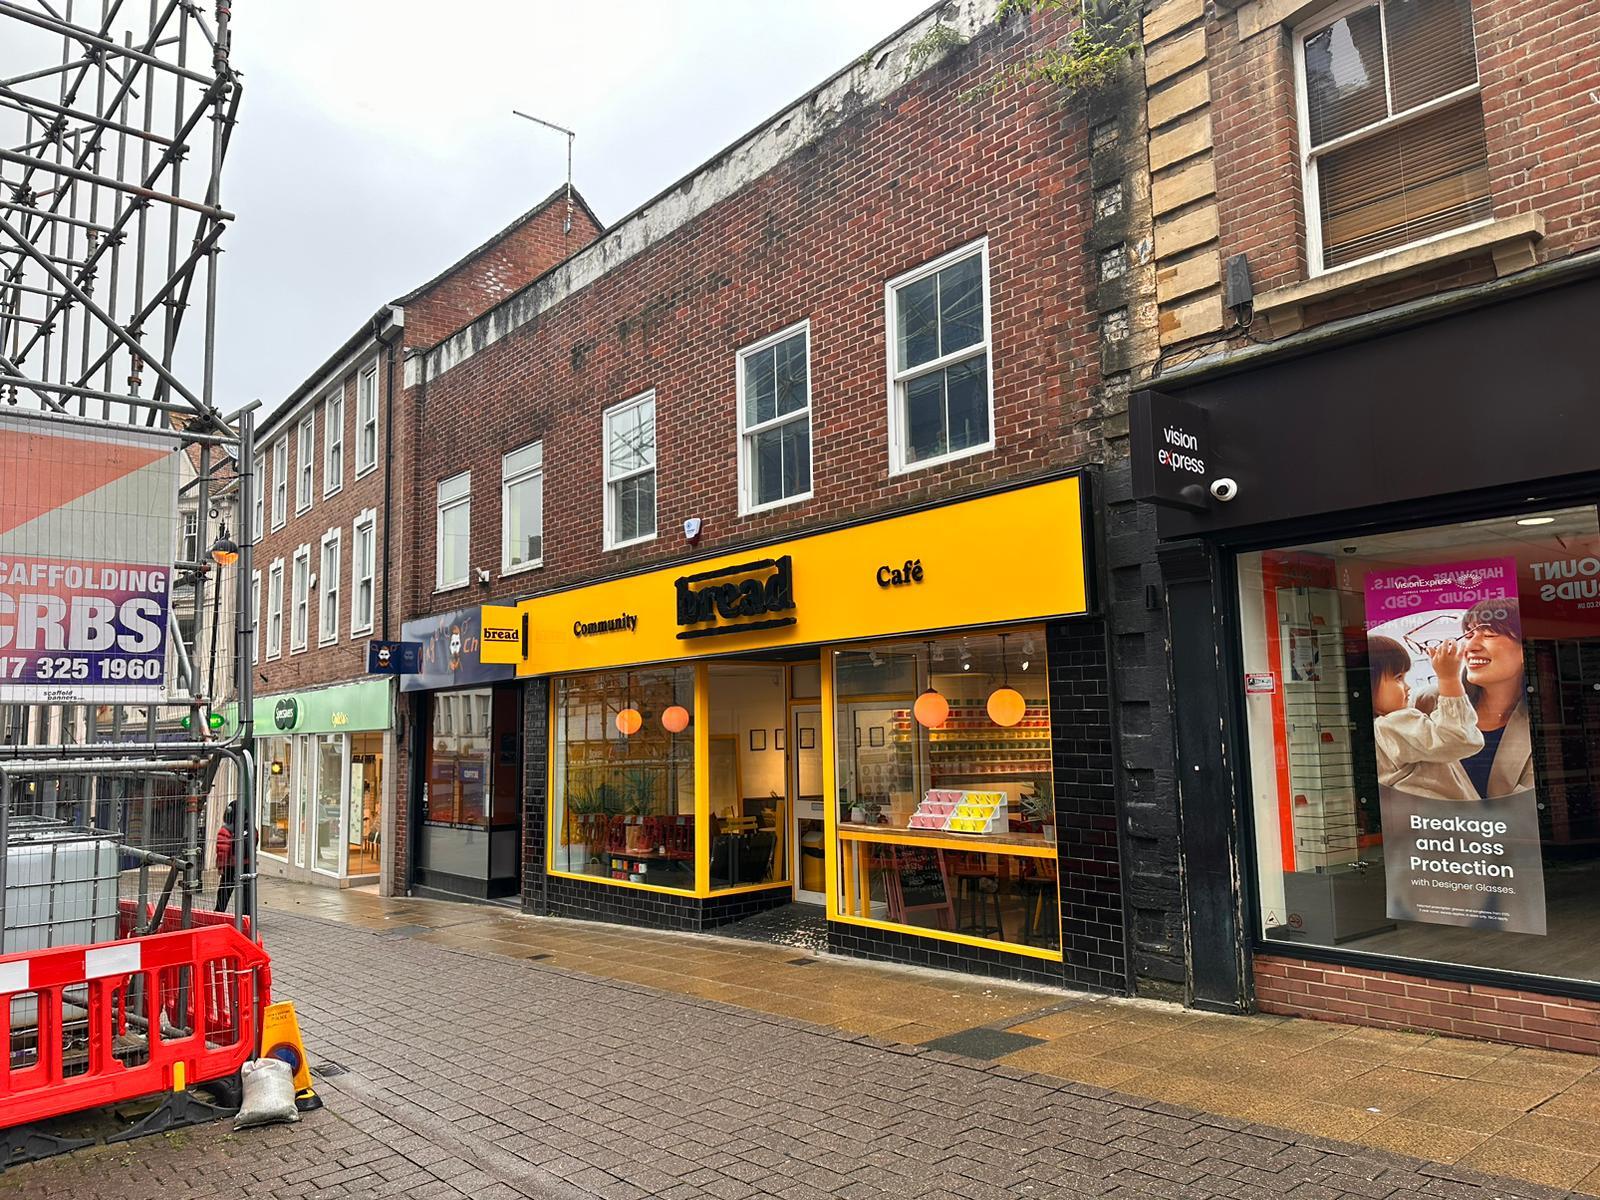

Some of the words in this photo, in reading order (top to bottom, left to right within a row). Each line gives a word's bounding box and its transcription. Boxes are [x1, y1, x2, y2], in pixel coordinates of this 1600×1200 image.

[1163, 425, 1198, 451] vision
[1158, 449, 1205, 474] express
[876, 559, 924, 589] Café
[1394, 577, 1452, 590] VisionExpress
[674, 555, 796, 626] bread
[484, 628, 519, 640] bread
[573, 613, 638, 637] Community
[36, 657, 89, 680] 325
[98, 658, 161, 680] 1960
[1410, 815, 1507, 838] Breakage
[1416, 837, 1455, 852] and
[1459, 838, 1504, 856] Loss
[1410, 856, 1514, 878] Protection
[1411, 878, 1430, 887] with
[1432, 879, 1473, 892] Designer
[1475, 883, 1517, 895] Glasses.
